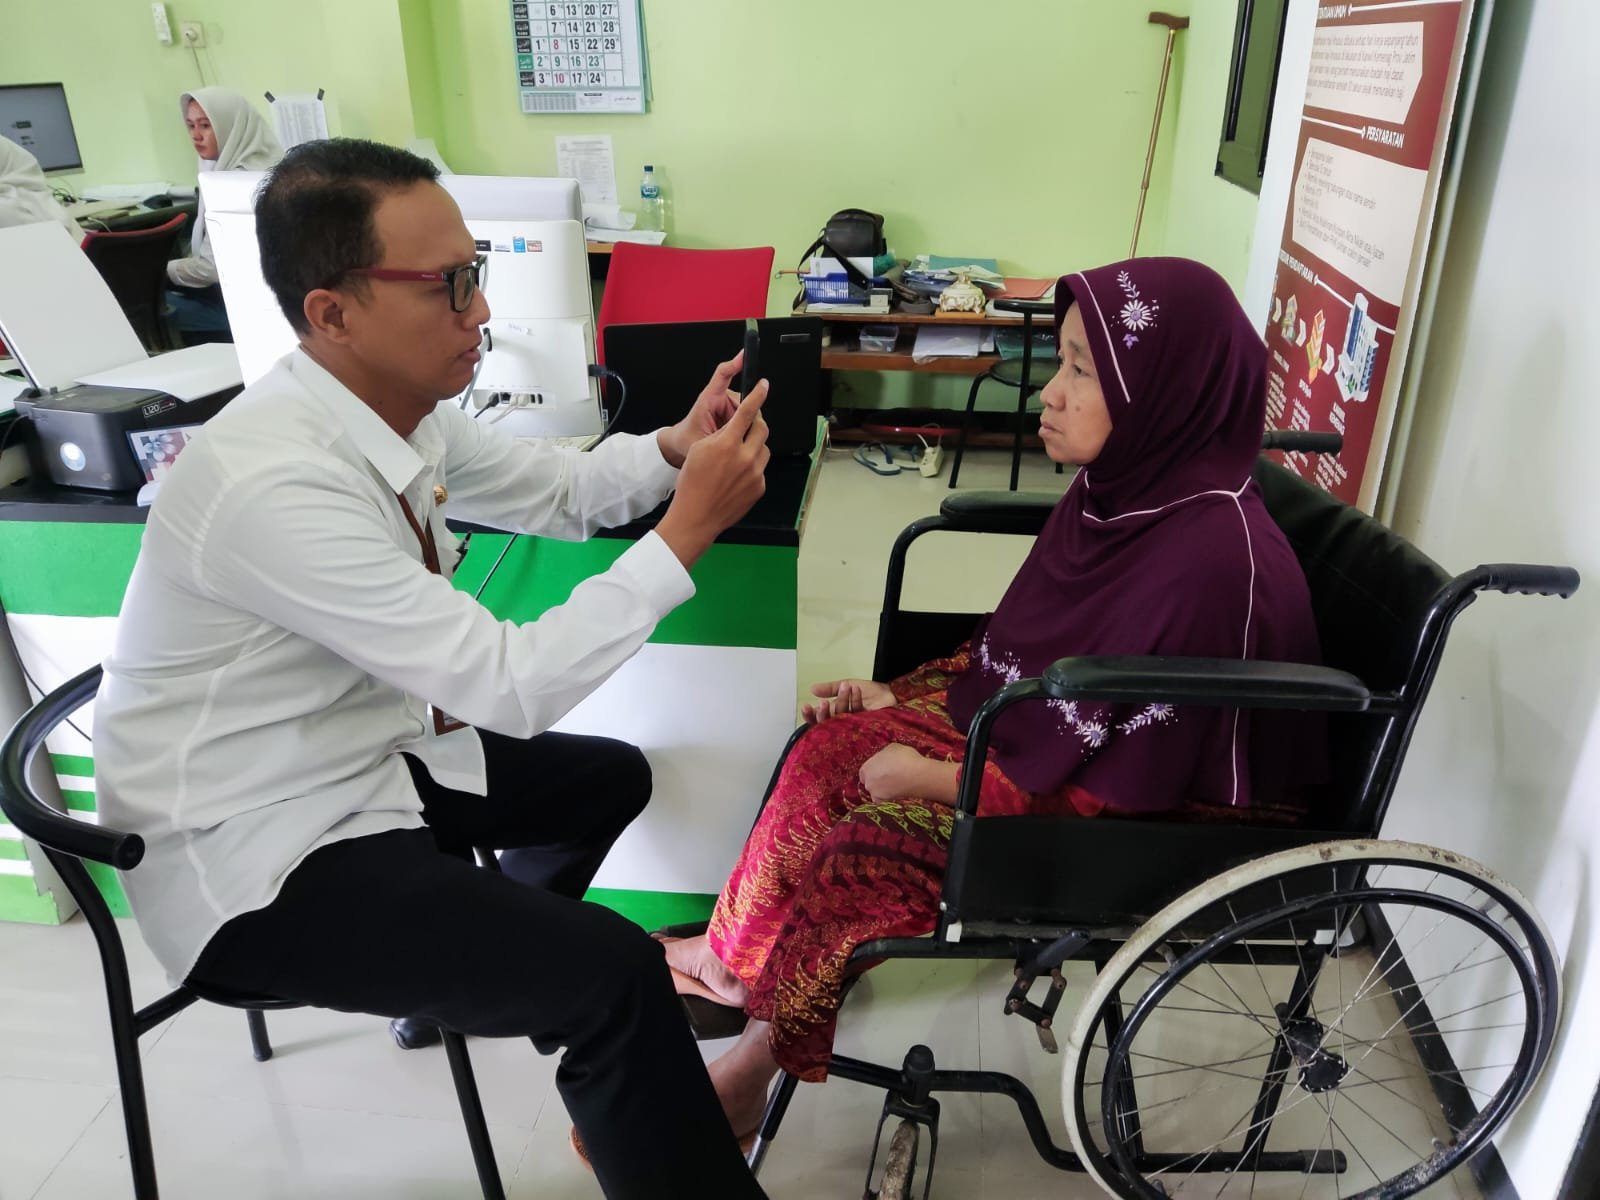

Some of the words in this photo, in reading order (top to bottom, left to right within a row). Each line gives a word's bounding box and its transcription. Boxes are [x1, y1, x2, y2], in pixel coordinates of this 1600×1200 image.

[567, 5, 577, 15] 13
[585, 5, 595, 15] 20
[602, 4, 612, 15] 27
[568, 22, 578, 32] 14
[586, 22, 596, 32] 21
[603, 21, 614, 32] 28
[569, 39, 580, 50] 15
[587, 39, 598, 49] 22
[605, 39, 615, 49] 29
[571, 56, 581, 67] 16
[589, 56, 599, 66] 23
[555, 73, 565, 83] 10
[572, 73, 582, 83] 17
[590, 73, 601, 83] 24
[1366, 126, 1404, 149] PERSYARATAN
